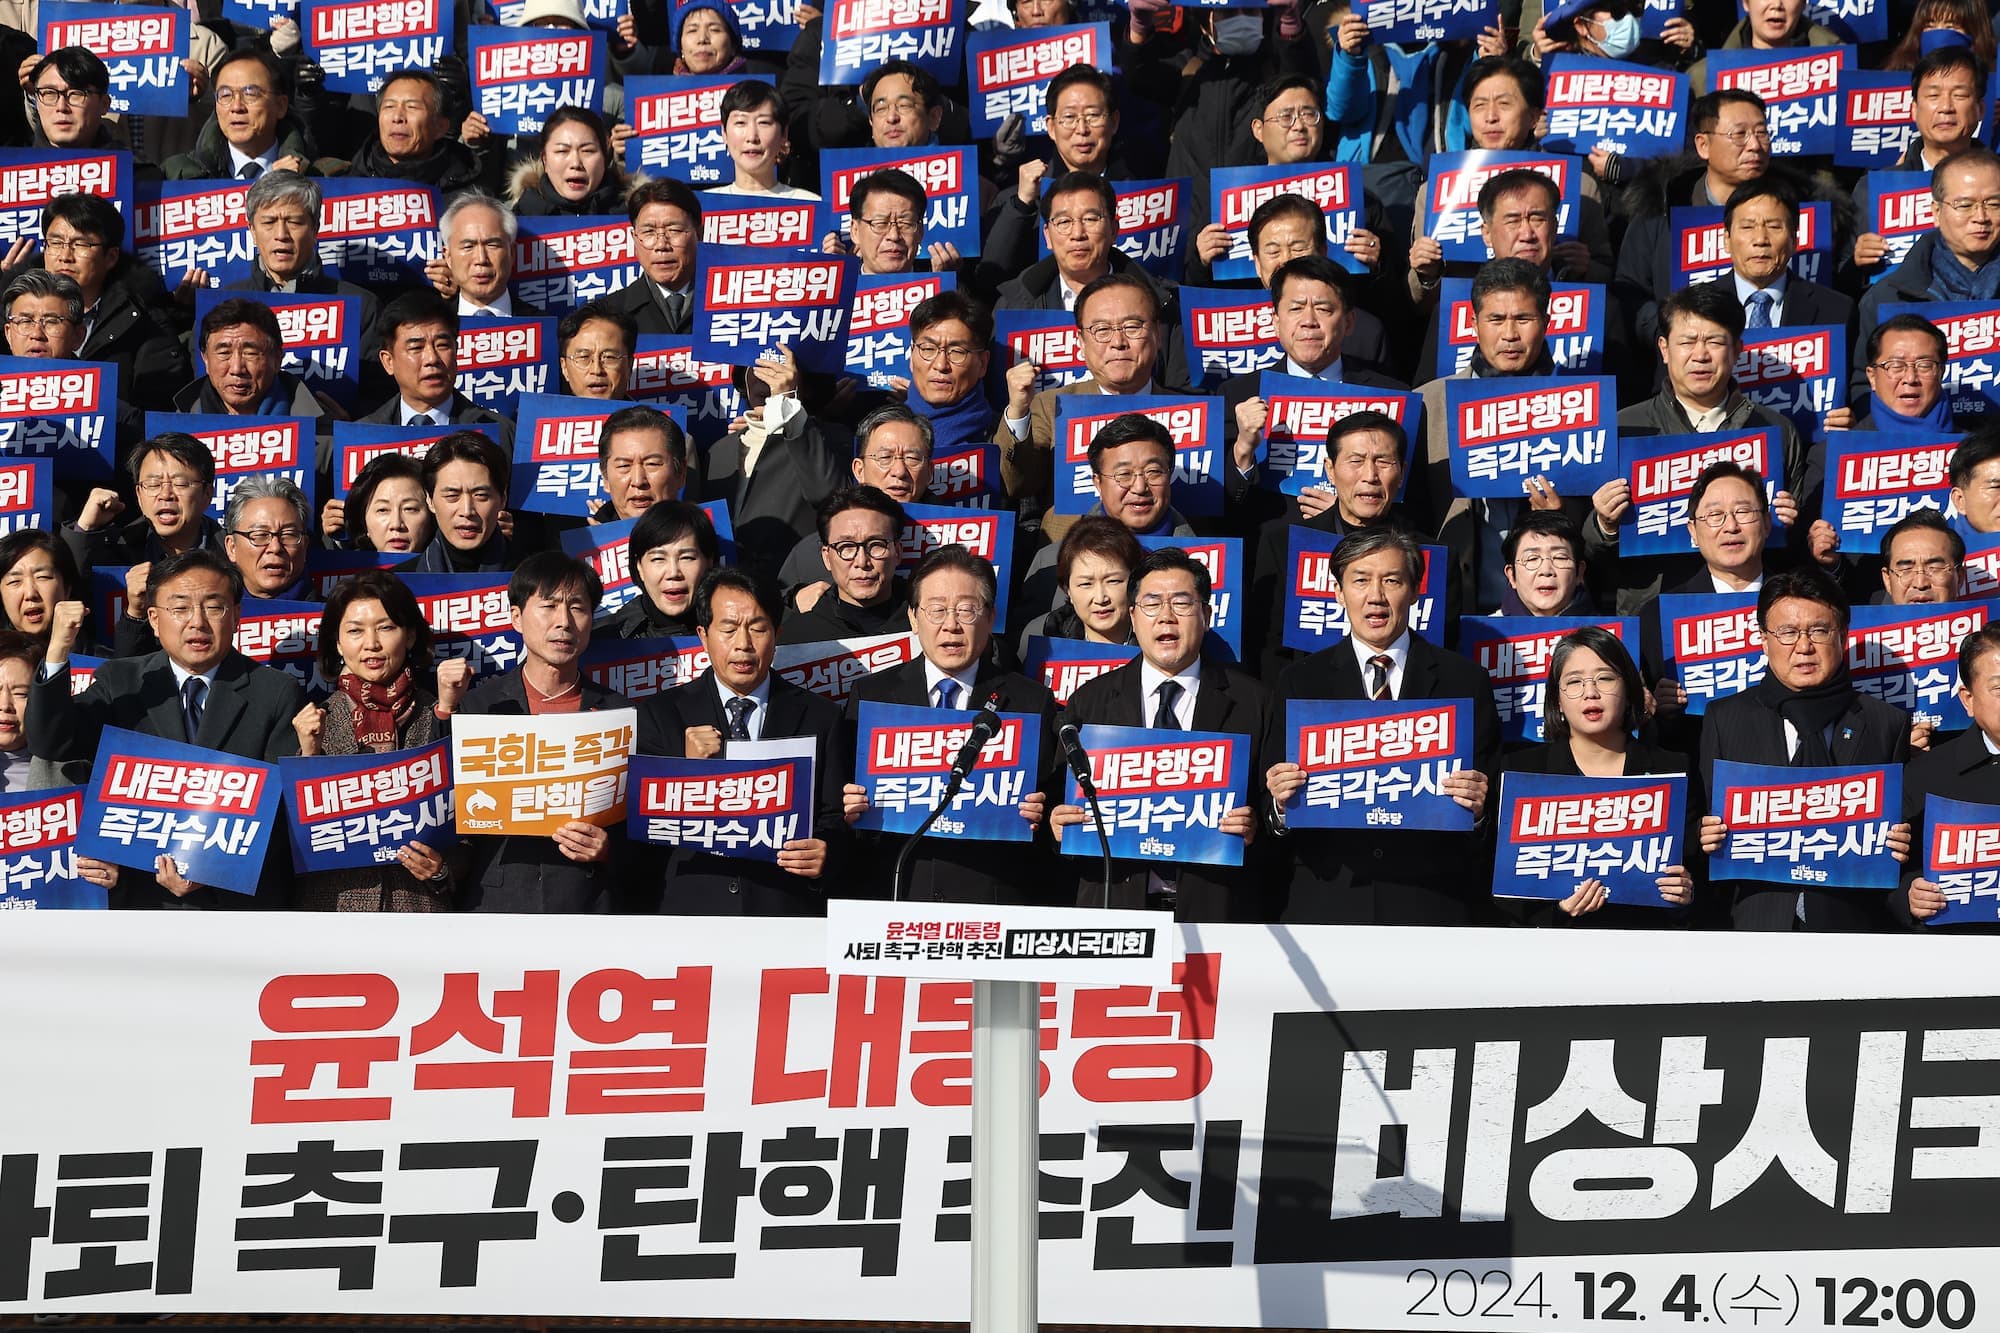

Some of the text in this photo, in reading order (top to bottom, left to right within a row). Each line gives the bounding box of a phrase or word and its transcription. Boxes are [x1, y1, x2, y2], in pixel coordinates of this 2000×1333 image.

[52, 18, 170, 53] 내란행위
[318, 0, 432, 41] 내란행위
[837, 0, 948, 33] 내란행위
[319, 36, 444, 77] 즉각수사!
[480, 40, 588, 81] 내란행위
[835, 27, 956, 68] 즉각수사!
[983, 33, 1091, 85] 내란행위
[108, 56, 179, 91] 수사!
[1553, 74, 1670, 105] 내란행위
[481, 78, 595, 118] 즉각수사!
[640, 89, 724, 131] 내란행
[1852, 89, 1913, 122] 내란
[1550, 108, 1677, 138] 즉각수사!
[641, 129, 728, 168] 즉각수
[1772, 141, 1802, 153] 민주당
[690, 168, 721, 181] 민주당
[319, 192, 432, 233] 내란행위
[1117, 190, 1173, 230] 행위
[1884, 193, 1934, 229] 내란
[137, 235, 258, 275] 즉각수사
[318, 230, 443, 267] 즉각수사!
[517, 227, 635, 272] 내란행위
[1117, 225, 1181, 258] 수사!
[518, 266, 643, 312] 즉각수사
[711, 266, 838, 305] 내란행위
[850, 283, 934, 329] 란행위
[278, 305, 338, 344] 행위
[709, 309, 844, 347] 즉각수사!
[1198, 308, 1278, 344] 내란행
[457, 328, 536, 366] 란행위
[1013, 332, 1083, 366] 내란
[1732, 336, 1824, 382] 란행위
[454, 364, 548, 401] 각수사!
[629, 351, 731, 390] 란행위
[1465, 387, 1594, 440] 내란행위
[207, 427, 292, 470] 란행위
[536, 418, 600, 457] 내란
[1467, 430, 1607, 480] 즉각수사!
[928, 454, 980, 496] 행위
[1843, 447, 1951, 493] 내란행
[901, 521, 990, 557] 란행위
[419, 591, 513, 635] 내란행
[1299, 595, 1434, 636] 즉각!
[1680, 616, 1765, 656] 내란
[592, 651, 711, 699] 내란행
[1480, 641, 1549, 679] 내란
[1852, 667, 1960, 709] 즉각수
[460, 725, 633, 778] 국회는 즉각
[1306, 711, 1449, 767] 내란행위
[108, 761, 259, 809] 내란행위
[304, 753, 441, 817] 내란행위
[1090, 745, 1226, 790] 내란행위
[511, 771, 629, 823] 탄핵을!
[647, 771, 788, 812] 내란행위
[874, 770, 1026, 813] 즉각수사!
[1730, 775, 1878, 825] 내란행위
[0, 799, 78, 849] 행위
[99, 806, 260, 855] 즉각수사!
[310, 790, 455, 854] 즉각수사!
[647, 813, 799, 850] 즉각수사!
[1082, 790, 1235, 836] 즉각수사!
[1366, 812, 1404, 826] 민주당
[1518, 790, 1665, 837] 내란행위
[1139, 842, 1176, 857] 민주당
[1514, 835, 1673, 880] 즉각수사!
[1730, 822, 1890, 864] 즉각수사!
[1790, 867, 1828, 882] 민주당
[887, 921, 1001, 940] 윤석열 대통령
[1012, 932, 1147, 956] 비상시국대회
[843, 942, 1003, 961] 사퇴 촉구·탄핵 추진
[250, 965, 713, 1125] 윤석열
[234, 1126, 909, 1291] 촉구·탄핵
[934, 1120, 1243, 1271] 추진
[1405, 1267, 1560, 1321] 2024.
[1574, 1271, 1648, 1323] 12.
[1815, 1276, 1977, 1330] 12:00
